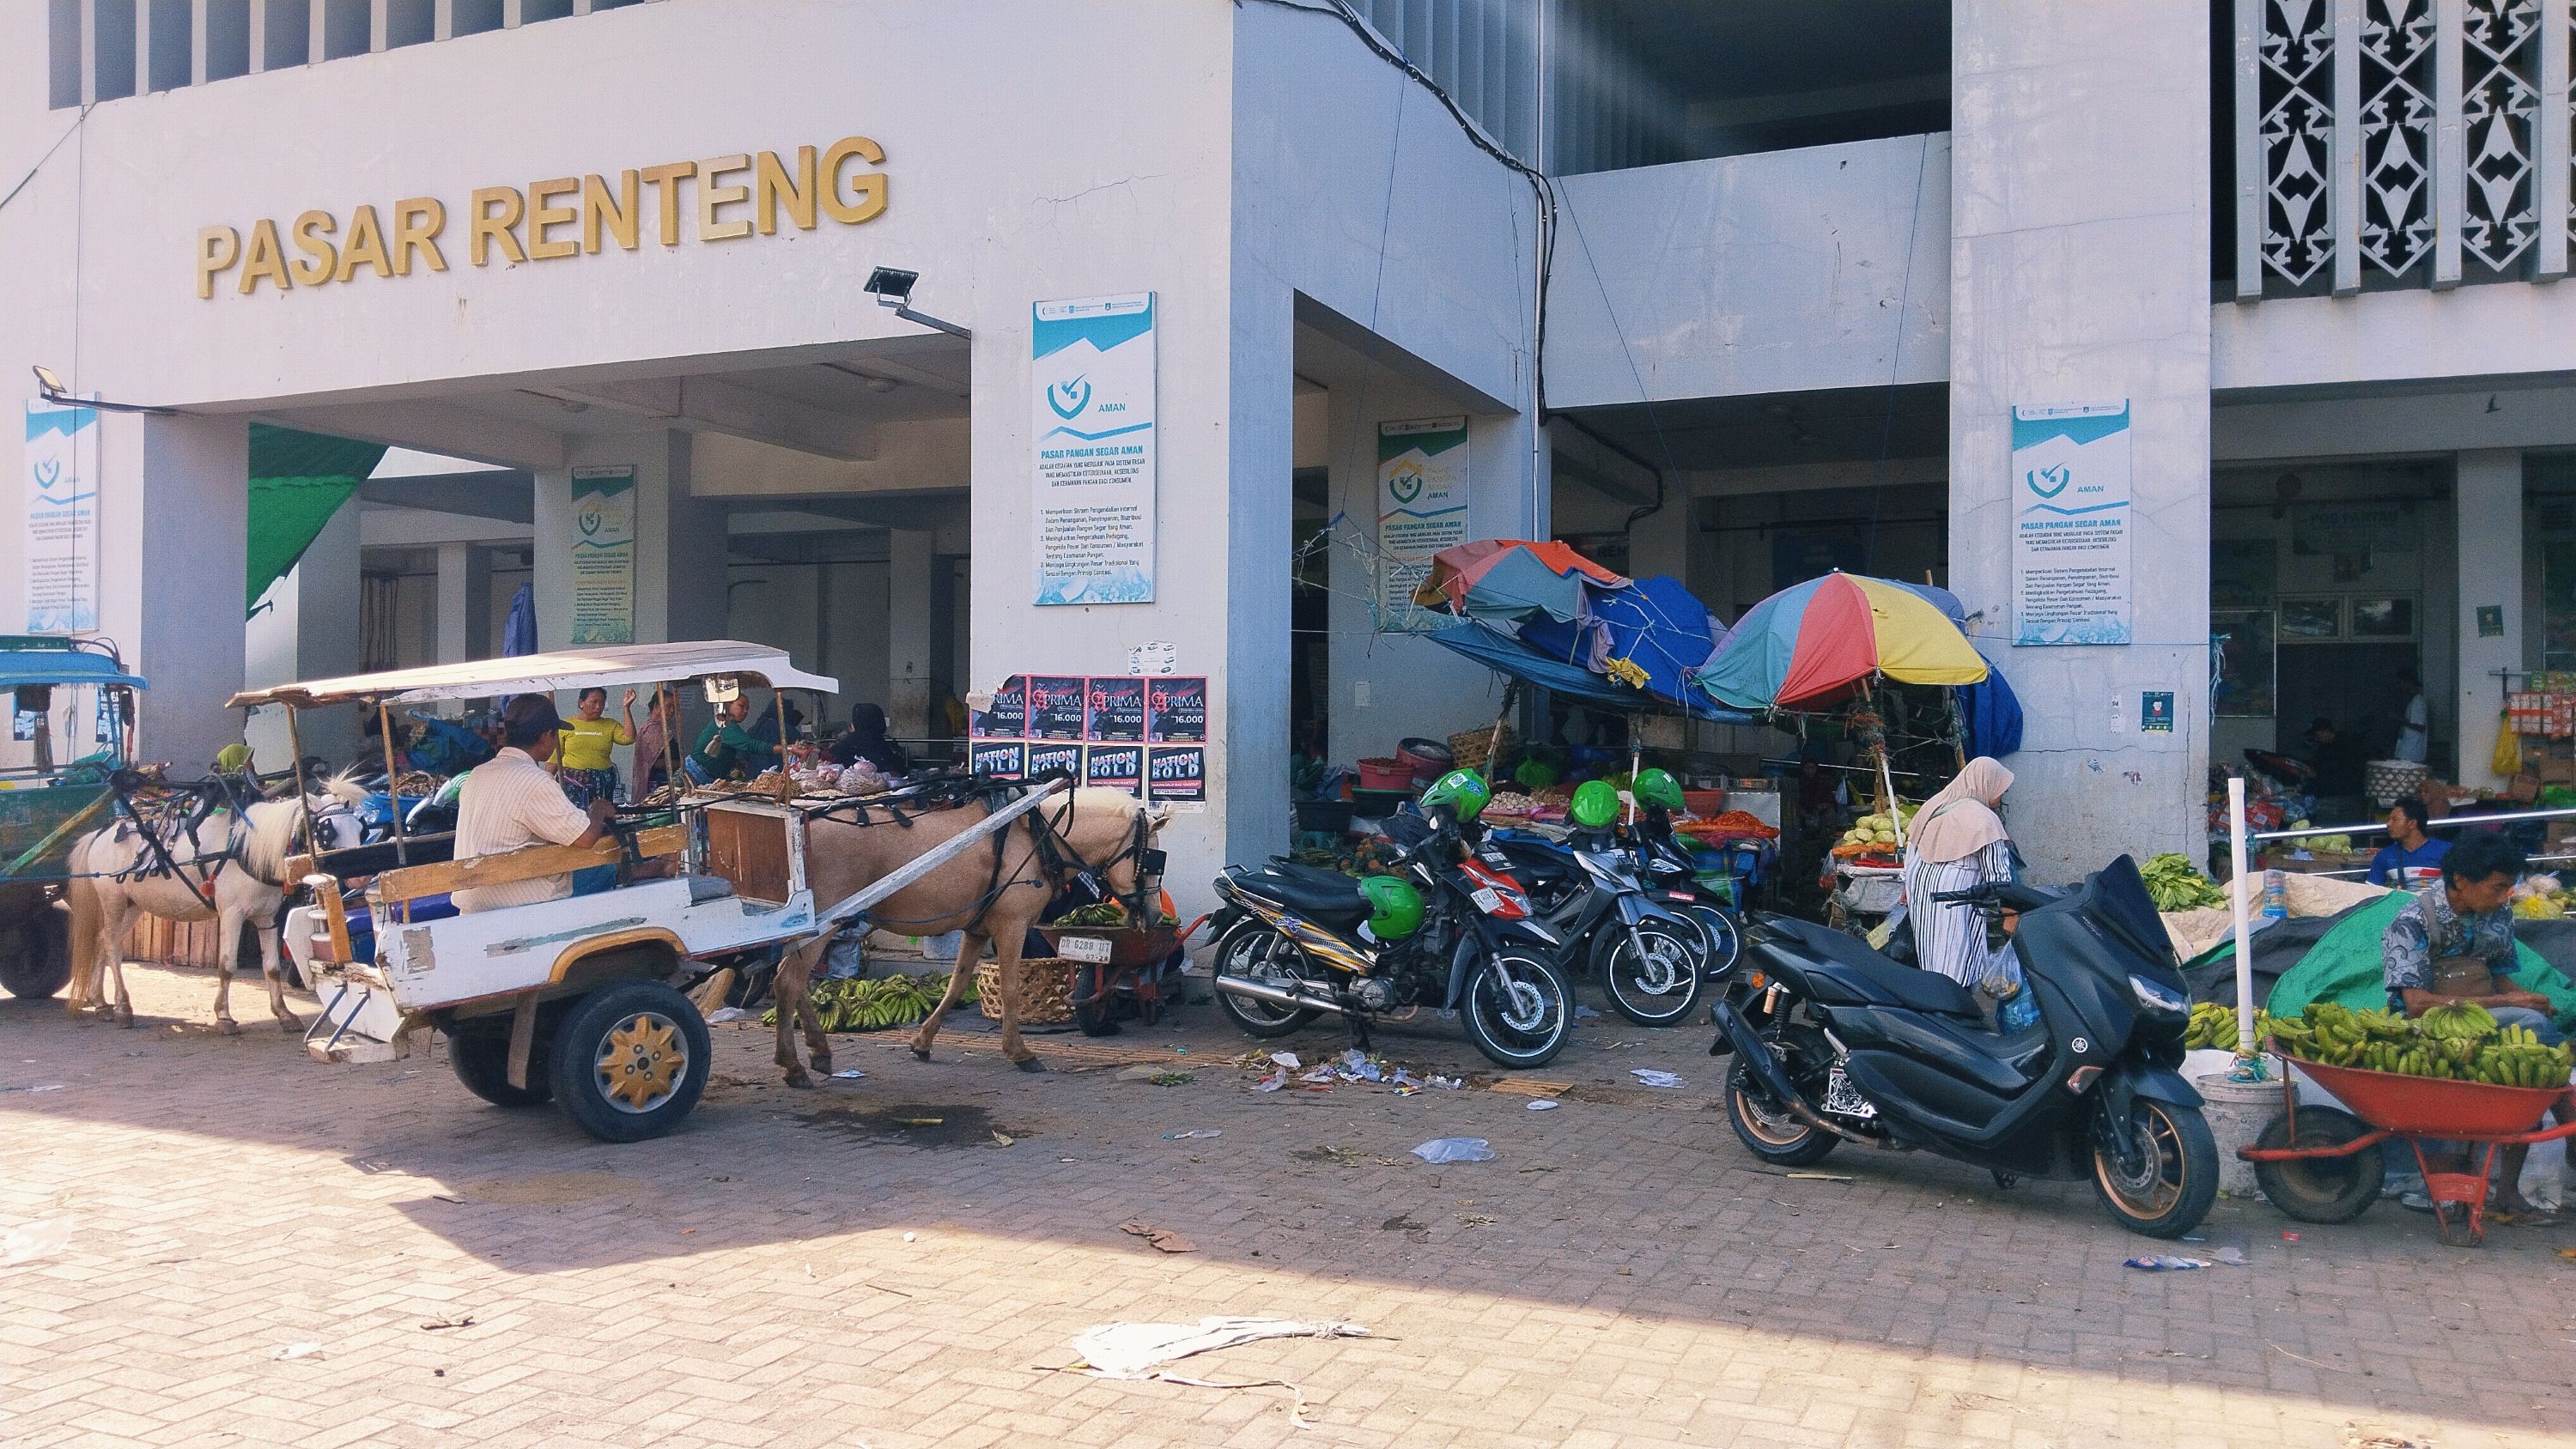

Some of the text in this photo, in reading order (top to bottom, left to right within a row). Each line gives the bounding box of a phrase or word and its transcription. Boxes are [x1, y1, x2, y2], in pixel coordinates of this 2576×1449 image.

[196, 135, 889, 299] PASAR RENTENG
[1098, 403, 1126, 412] AMAN
[1041, 446, 1143, 459] PASAR PANGAN SEGAR AMAN
[1427, 491, 1449, 500] AMAN
[993, 693, 1024, 705] RIMA
[1044, 694, 1081, 706] PRIMA
[1103, 696, 1142, 707] PRIMA
[1164, 696, 1203, 707] PRIMA
[1054, 713, 1081, 722] 16.000
[975, 747, 1019, 761] NATION
[1033, 749, 1076, 763] NATION
[1091, 751, 1137, 766] NATION
[1152, 752, 1200, 767] NATION
[1091, 762, 1136, 777] BOLD
[1152, 763, 1199, 779] BOLD
